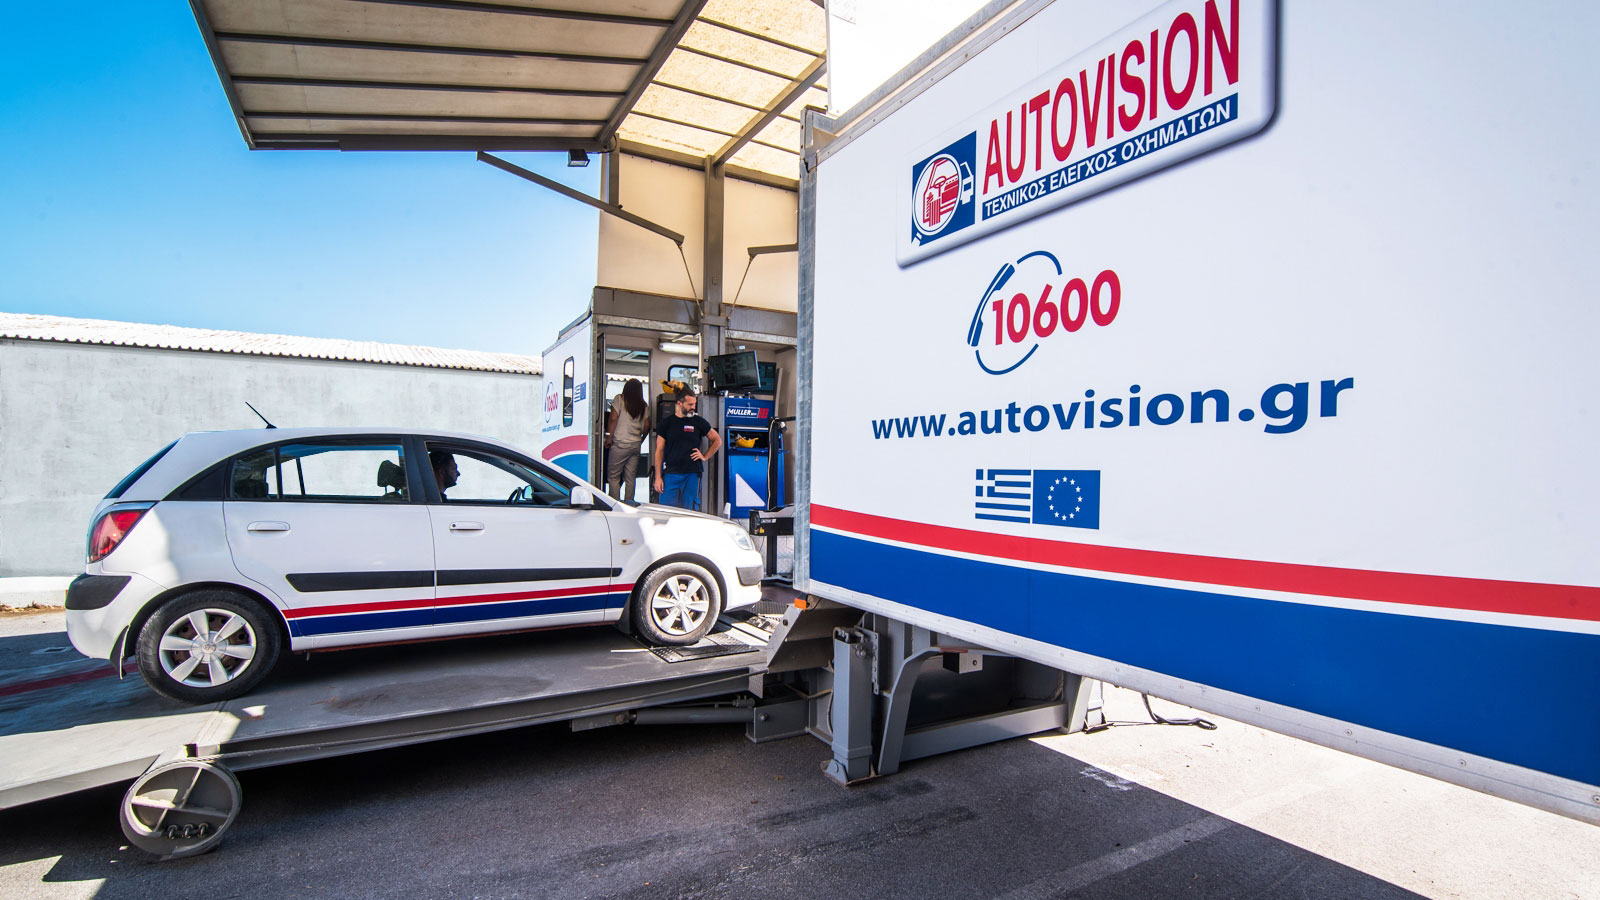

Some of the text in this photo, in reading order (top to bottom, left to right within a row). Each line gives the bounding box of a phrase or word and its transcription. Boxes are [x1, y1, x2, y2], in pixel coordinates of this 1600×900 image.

[983, 0, 1239, 195] AUTOVISION
[985, 100, 1231, 217] ΤΕΧΝΙΚΟΣ ΕΛΕΓΧΟΣ ΟΧΗΜΑΤΩΝ
[992, 269, 1122, 346] 10600
[727, 408, 752, 416] MULLER
[871, 377, 1354, 440] www.autovision.gr
